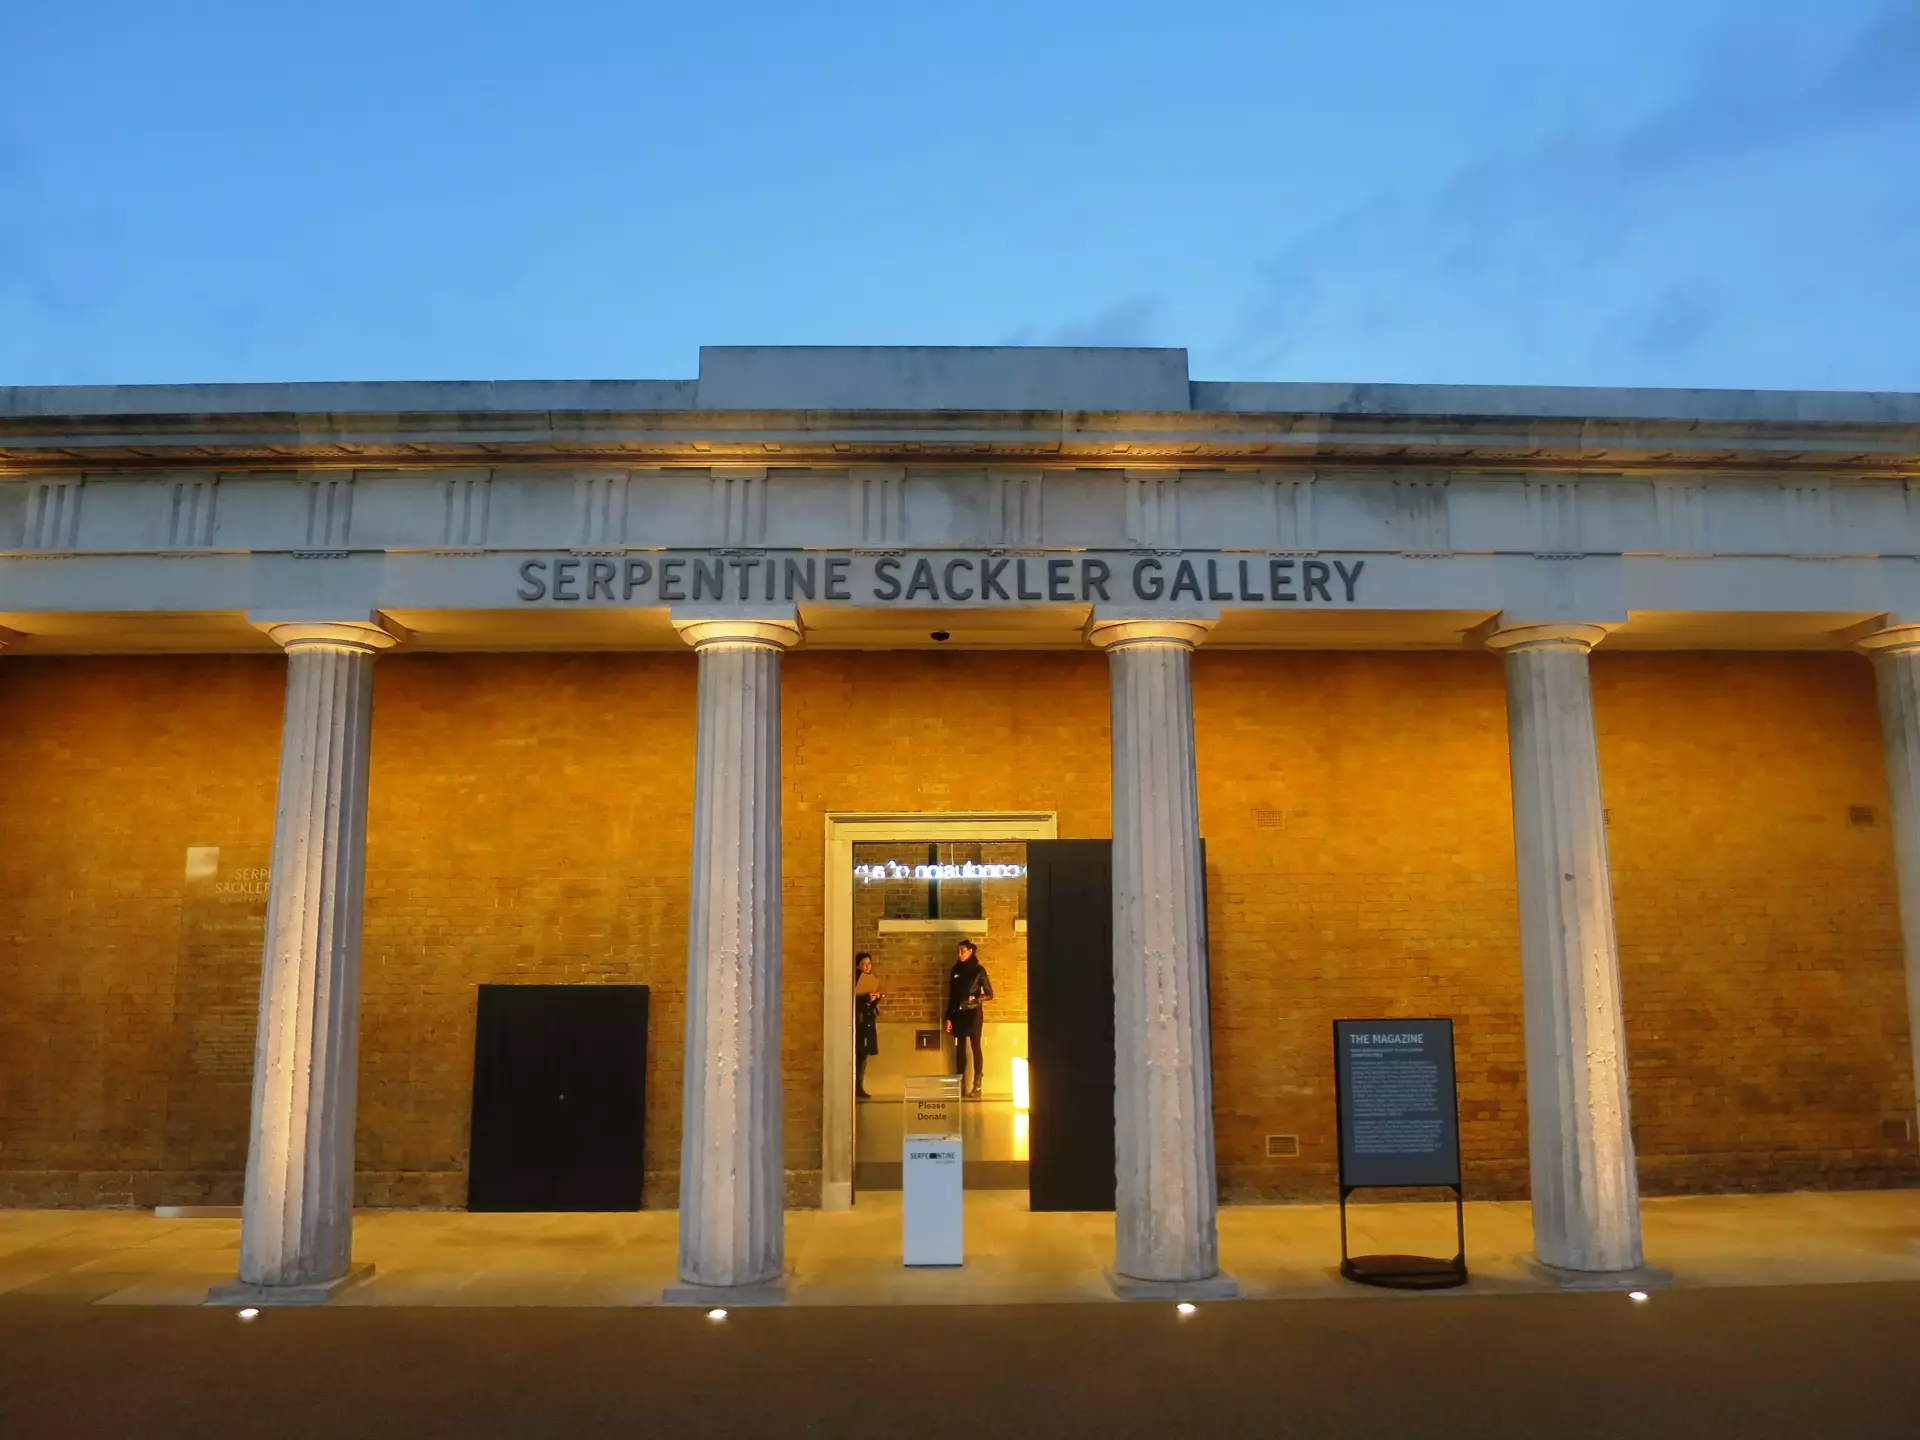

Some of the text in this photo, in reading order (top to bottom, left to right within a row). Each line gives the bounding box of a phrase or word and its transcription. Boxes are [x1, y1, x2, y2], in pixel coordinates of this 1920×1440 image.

[517, 557, 1365, 602] SERPENTINE SACKLER GALLERY
[235, 868, 272, 880] SERP
[1350, 1033, 1424, 1044] THE MAGAZINE
[918, 1101, 946, 1110] Please
[917, 1112, 947, 1121] Donate
